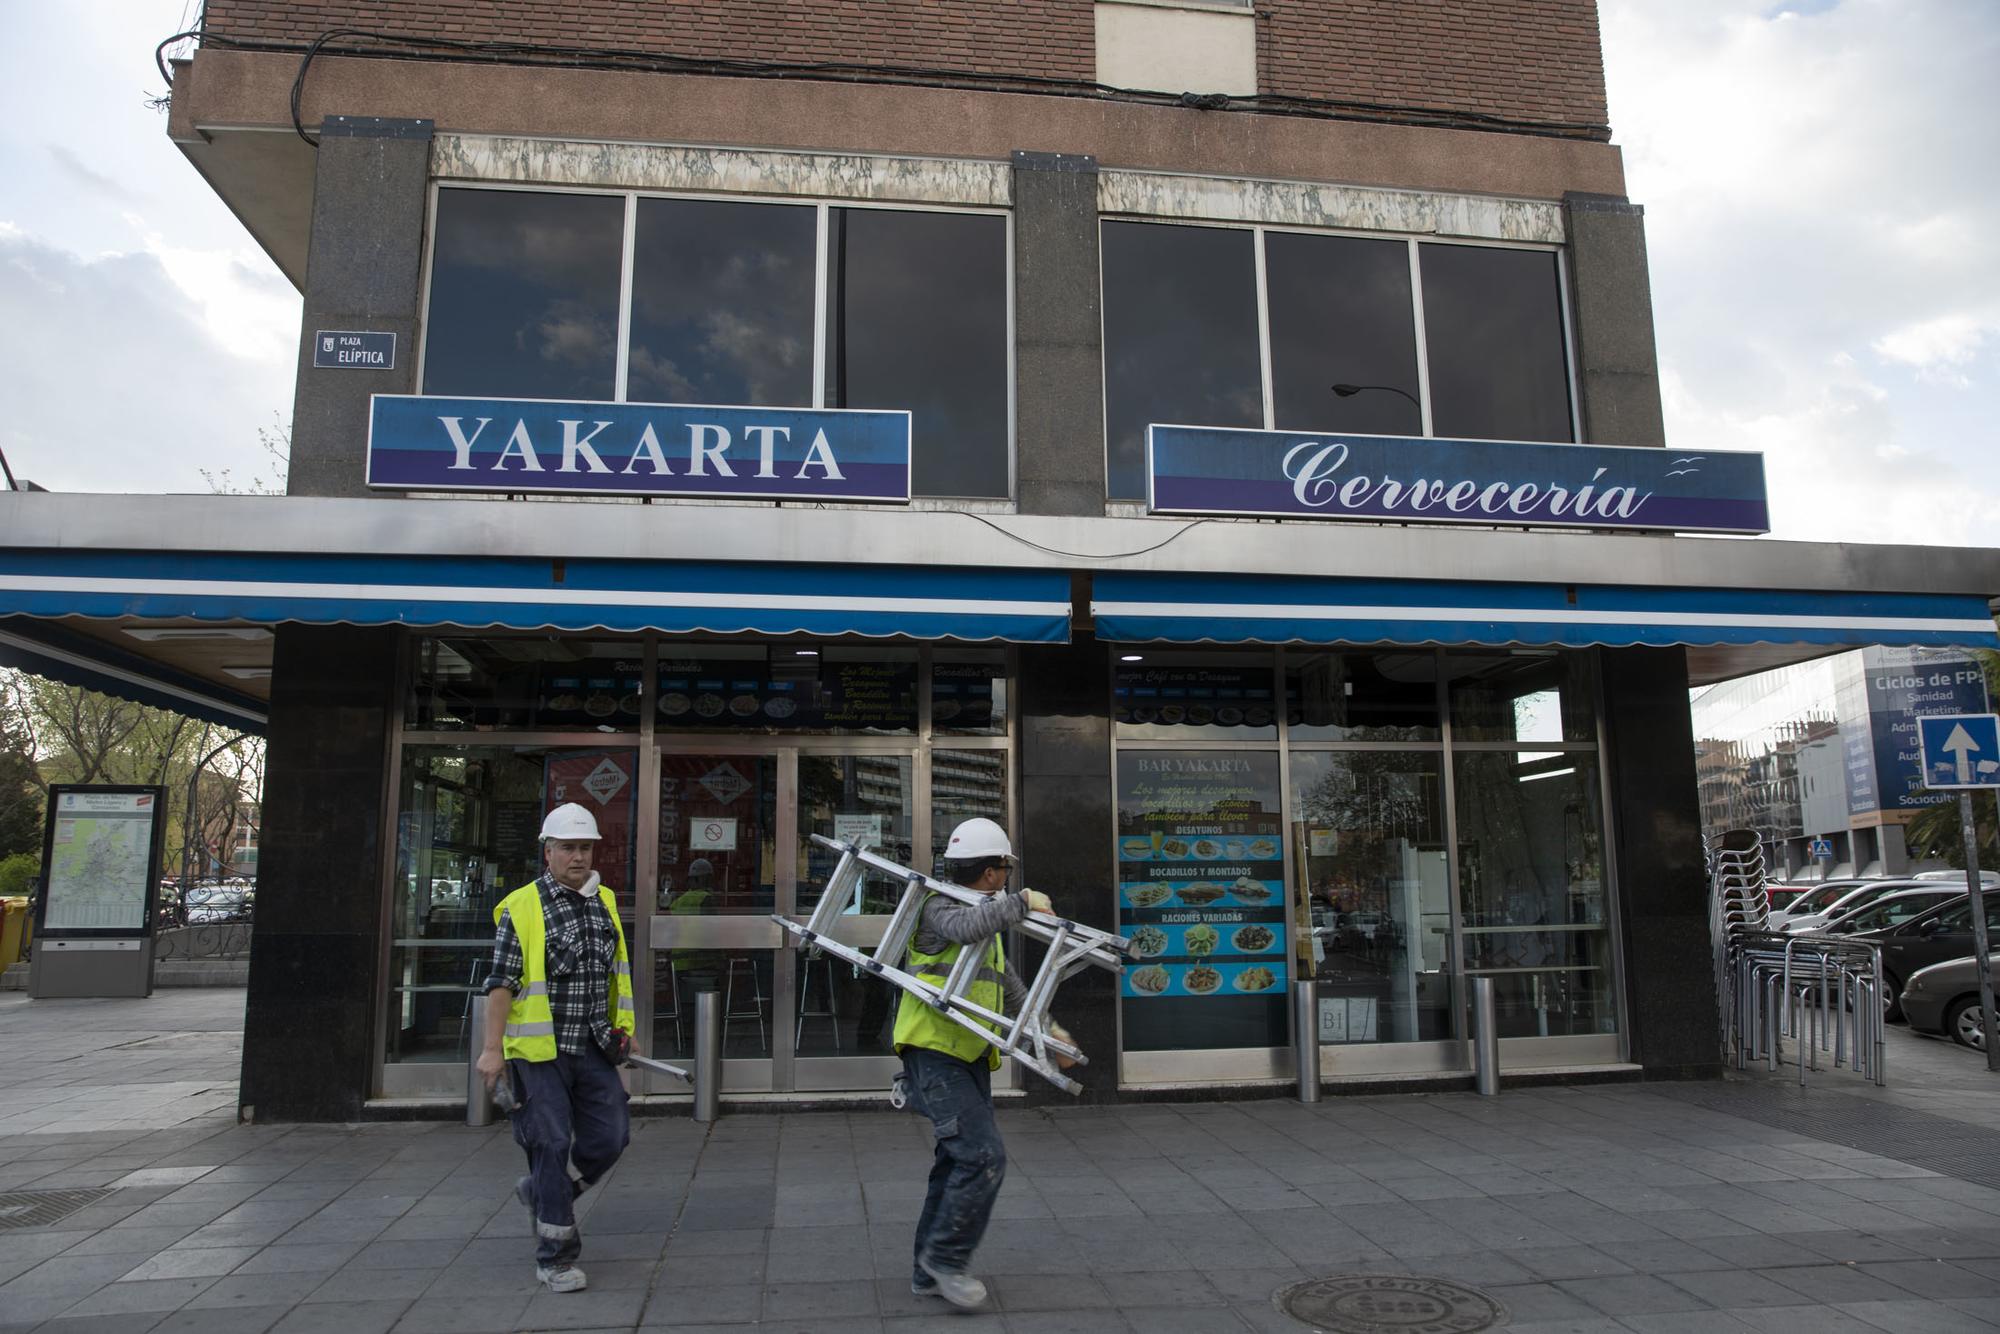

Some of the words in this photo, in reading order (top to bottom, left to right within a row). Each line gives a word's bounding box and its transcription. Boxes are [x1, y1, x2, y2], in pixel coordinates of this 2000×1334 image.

[340, 337, 361, 346] PLAZA
[338, 348, 384, 364] ELÍPTICA
[437, 416, 847, 480] YAKARTA
[1282, 442, 1653, 519] Cervecería
[1875, 676, 1925, 690] Ciclos
[1929, 673, 1951, 687] de
[1906, 690, 1954, 703] Sanidad
[1903, 704, 1963, 718] Marketing
[1138, 759, 1170, 772] BAR
[1175, 759, 1251, 772] YAKARTA
[1131, 782, 1153, 795] Los
[1158, 784, 1197, 797] mejores
[1141, 795, 1194, 808] bocadillos
[1187, 812, 1216, 823] para
[1176, 825, 1223, 835] DESAYUNOS
[1149, 867, 1198, 877] BOCADILLOS
[1200, 867, 1206, 876] Y
[1207, 867, 1252, 876] MONTADOS
[1161, 913, 1201, 923] RACIONES
[1202, 912, 1243, 922] VARIADAS
